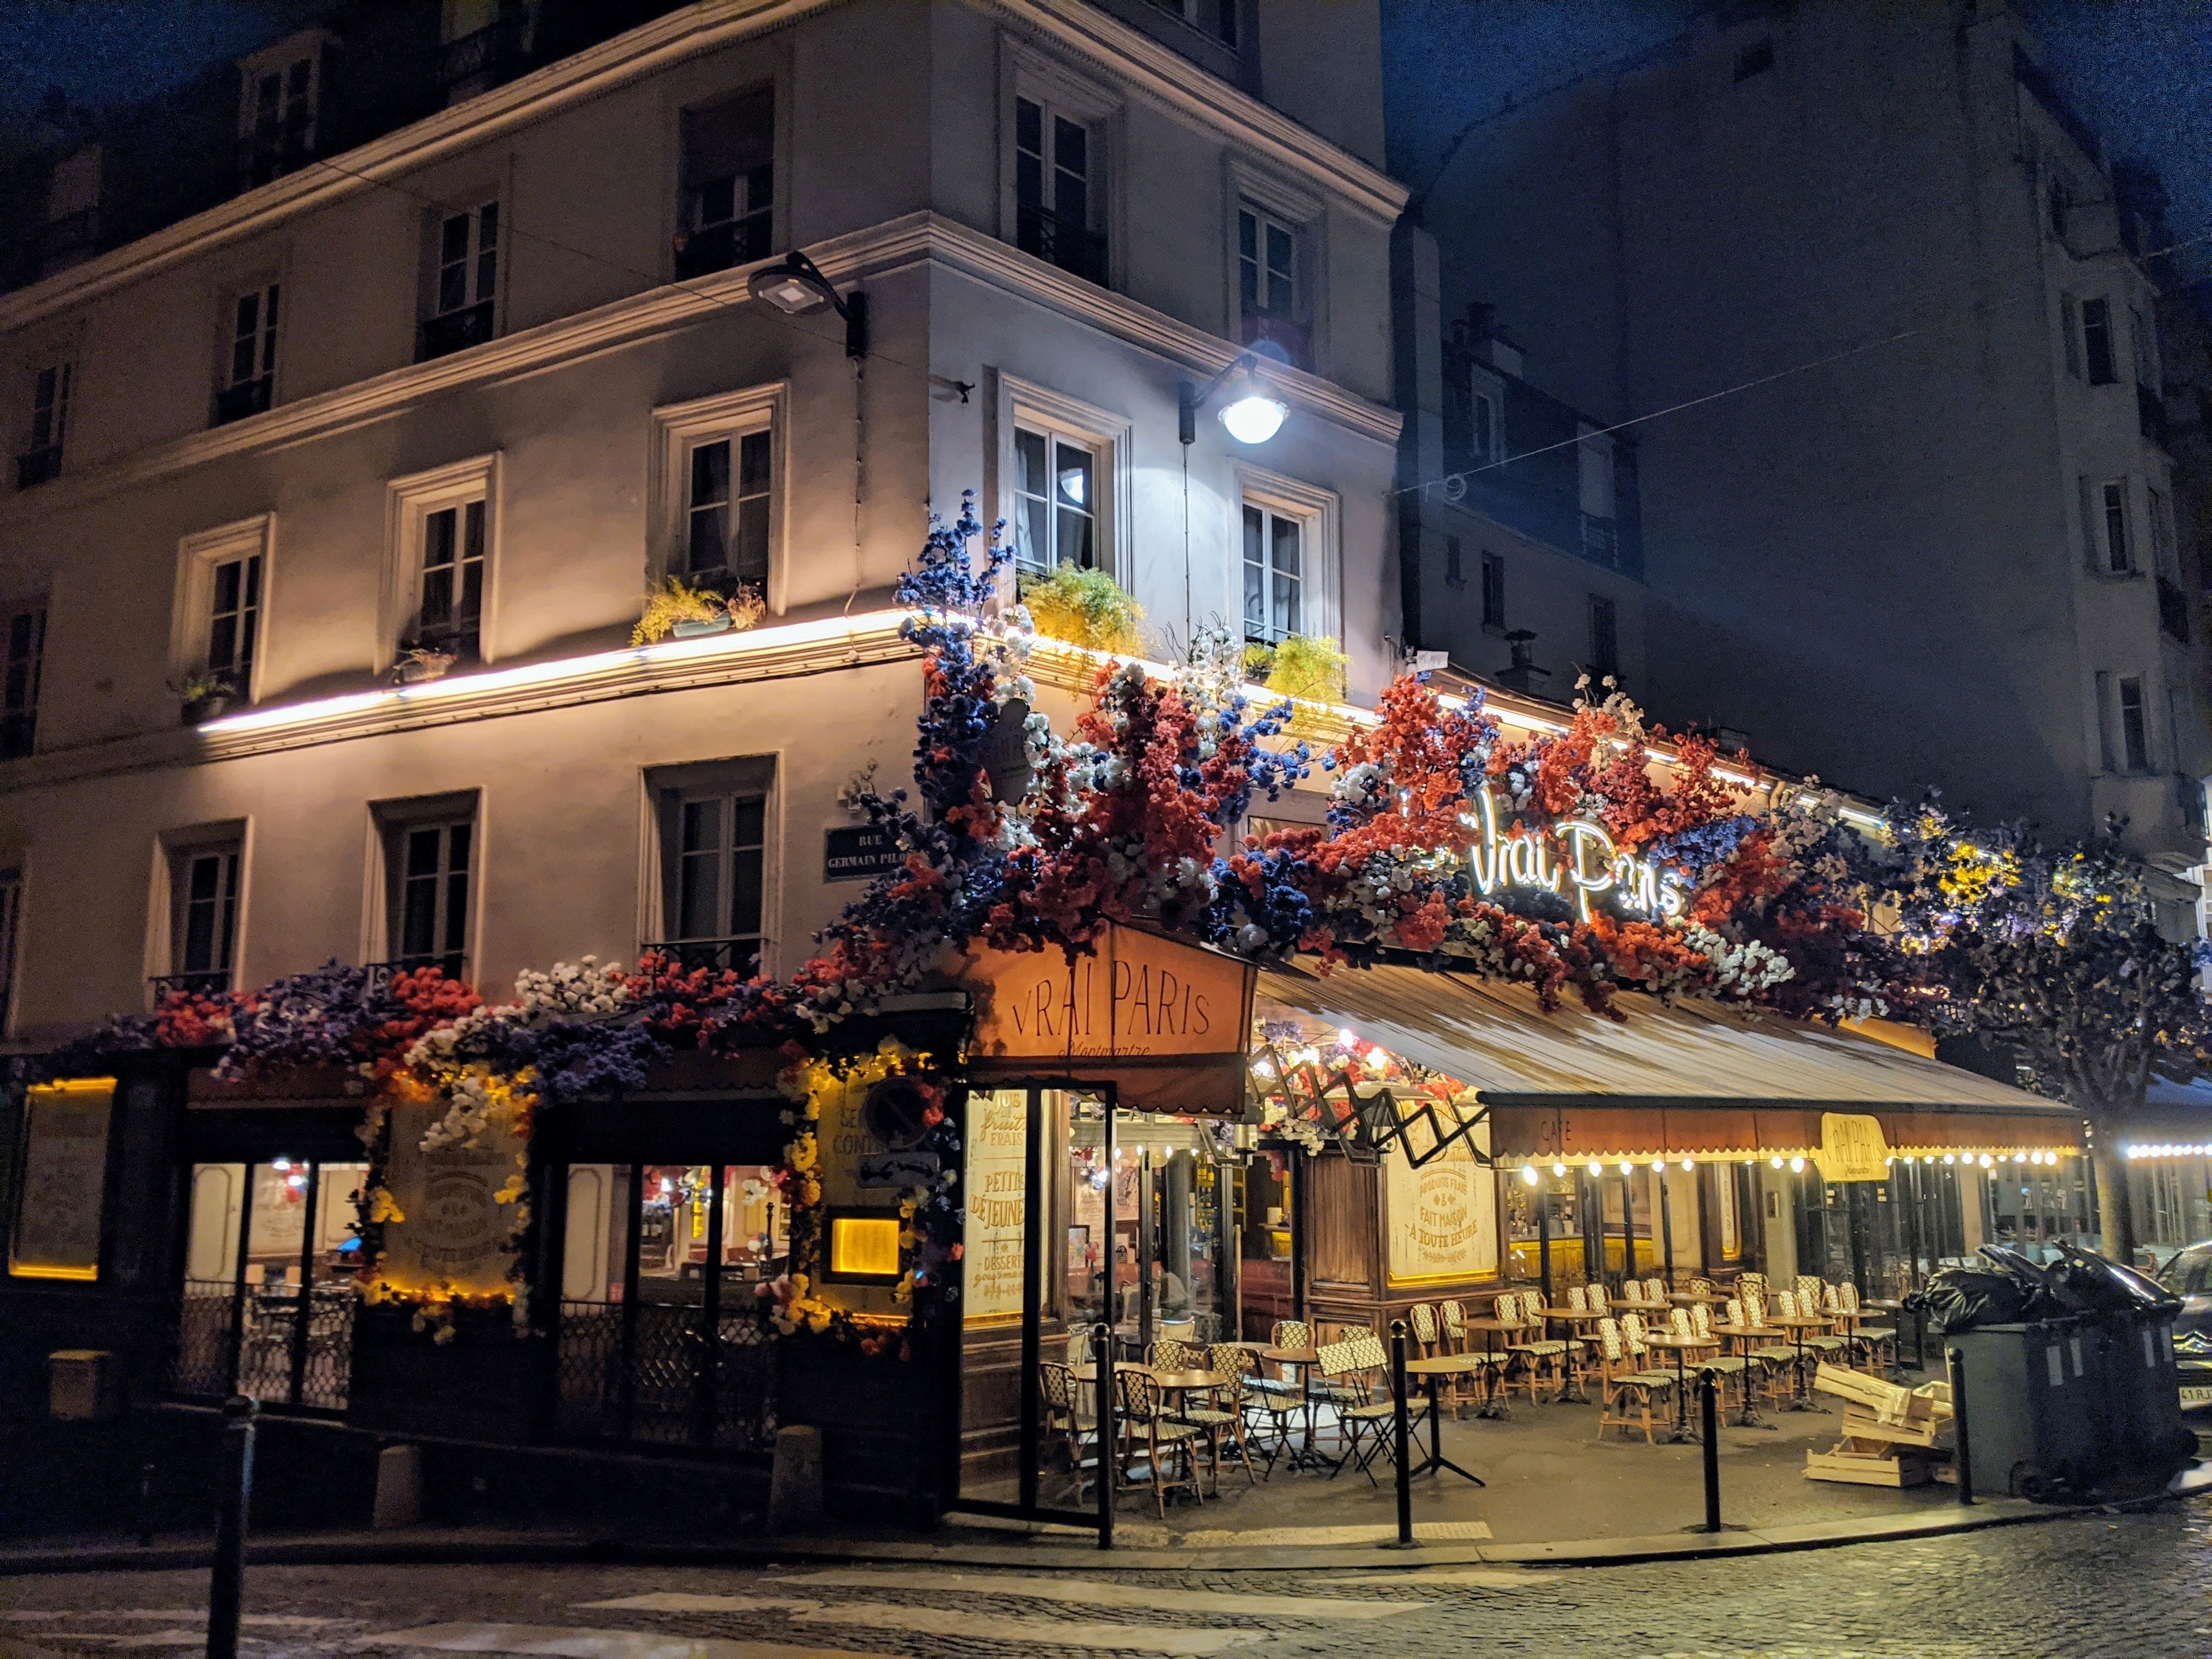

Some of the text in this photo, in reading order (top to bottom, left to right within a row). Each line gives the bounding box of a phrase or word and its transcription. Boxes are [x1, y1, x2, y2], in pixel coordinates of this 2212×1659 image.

[859, 834, 882, 846] RUE
[1459, 786, 1560, 895] Vrai
[828, 853, 906, 868] GERMAIN PILO
[1012, 960, 1209, 1036] VRAI PARIS
[995, 1092, 1021, 1114] JUS
[990, 1132, 1024, 1146] FRAIS
[985, 1170, 1025, 1192] PETITS
[1419, 1177, 1467, 1197] PRODUITS FRAIS
[970, 1193, 1025, 1229] DÉJEUNE
[1420, 1204, 1467, 1227] FAIT MAISON
[1418, 1228, 1448, 1248] TOUTE
[1450, 1218, 1478, 1246] HEURE
